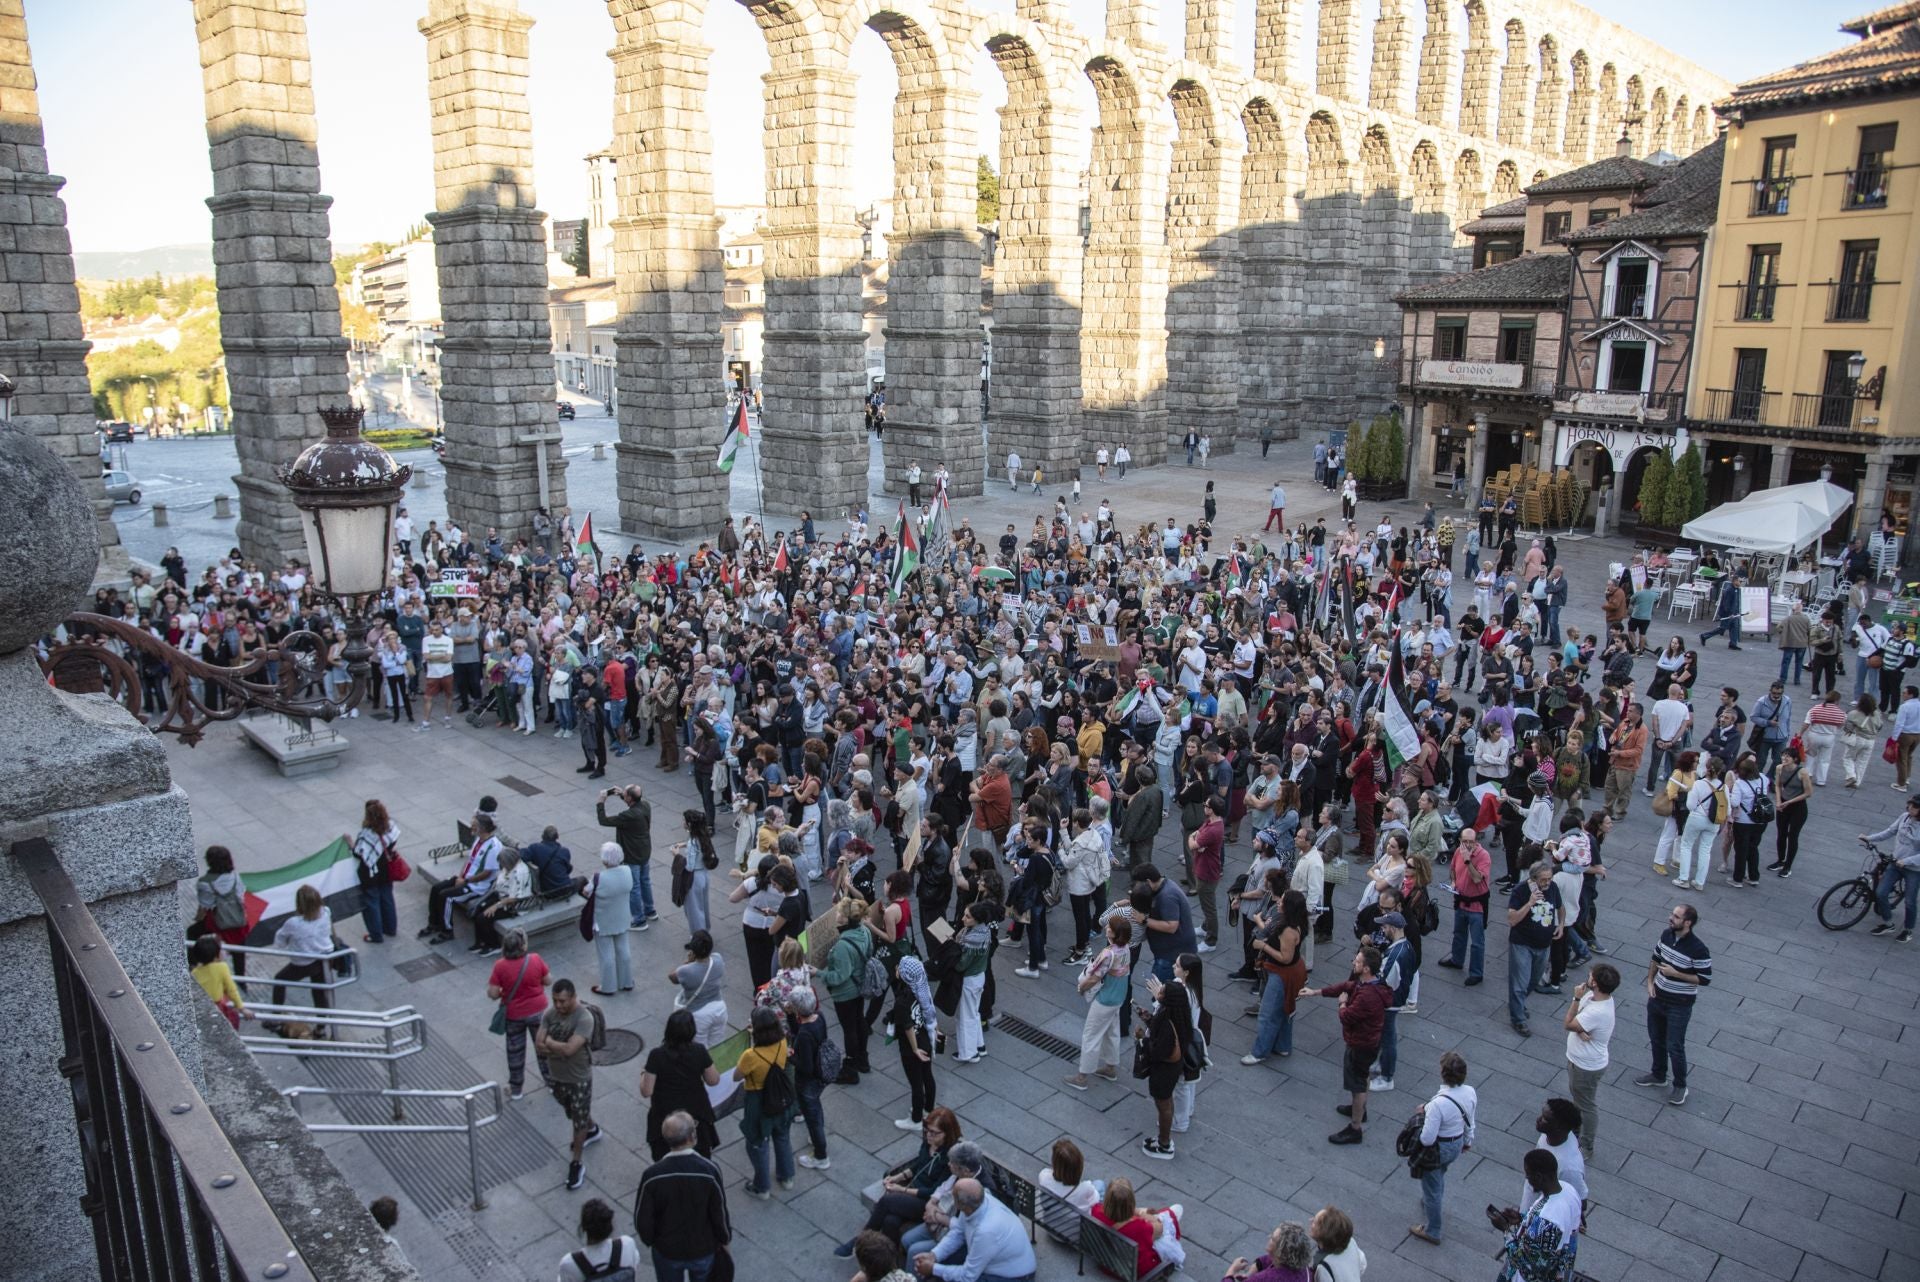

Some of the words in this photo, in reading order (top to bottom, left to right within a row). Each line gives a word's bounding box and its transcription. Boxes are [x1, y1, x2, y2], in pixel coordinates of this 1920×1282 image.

[1606, 328, 1621, 340] CASA
[1567, 428, 1615, 450] HORNO
[1614, 450, 1624, 459] DE
[442, 570, 467, 581] STOP
[1090, 627, 1104, 639] NO
